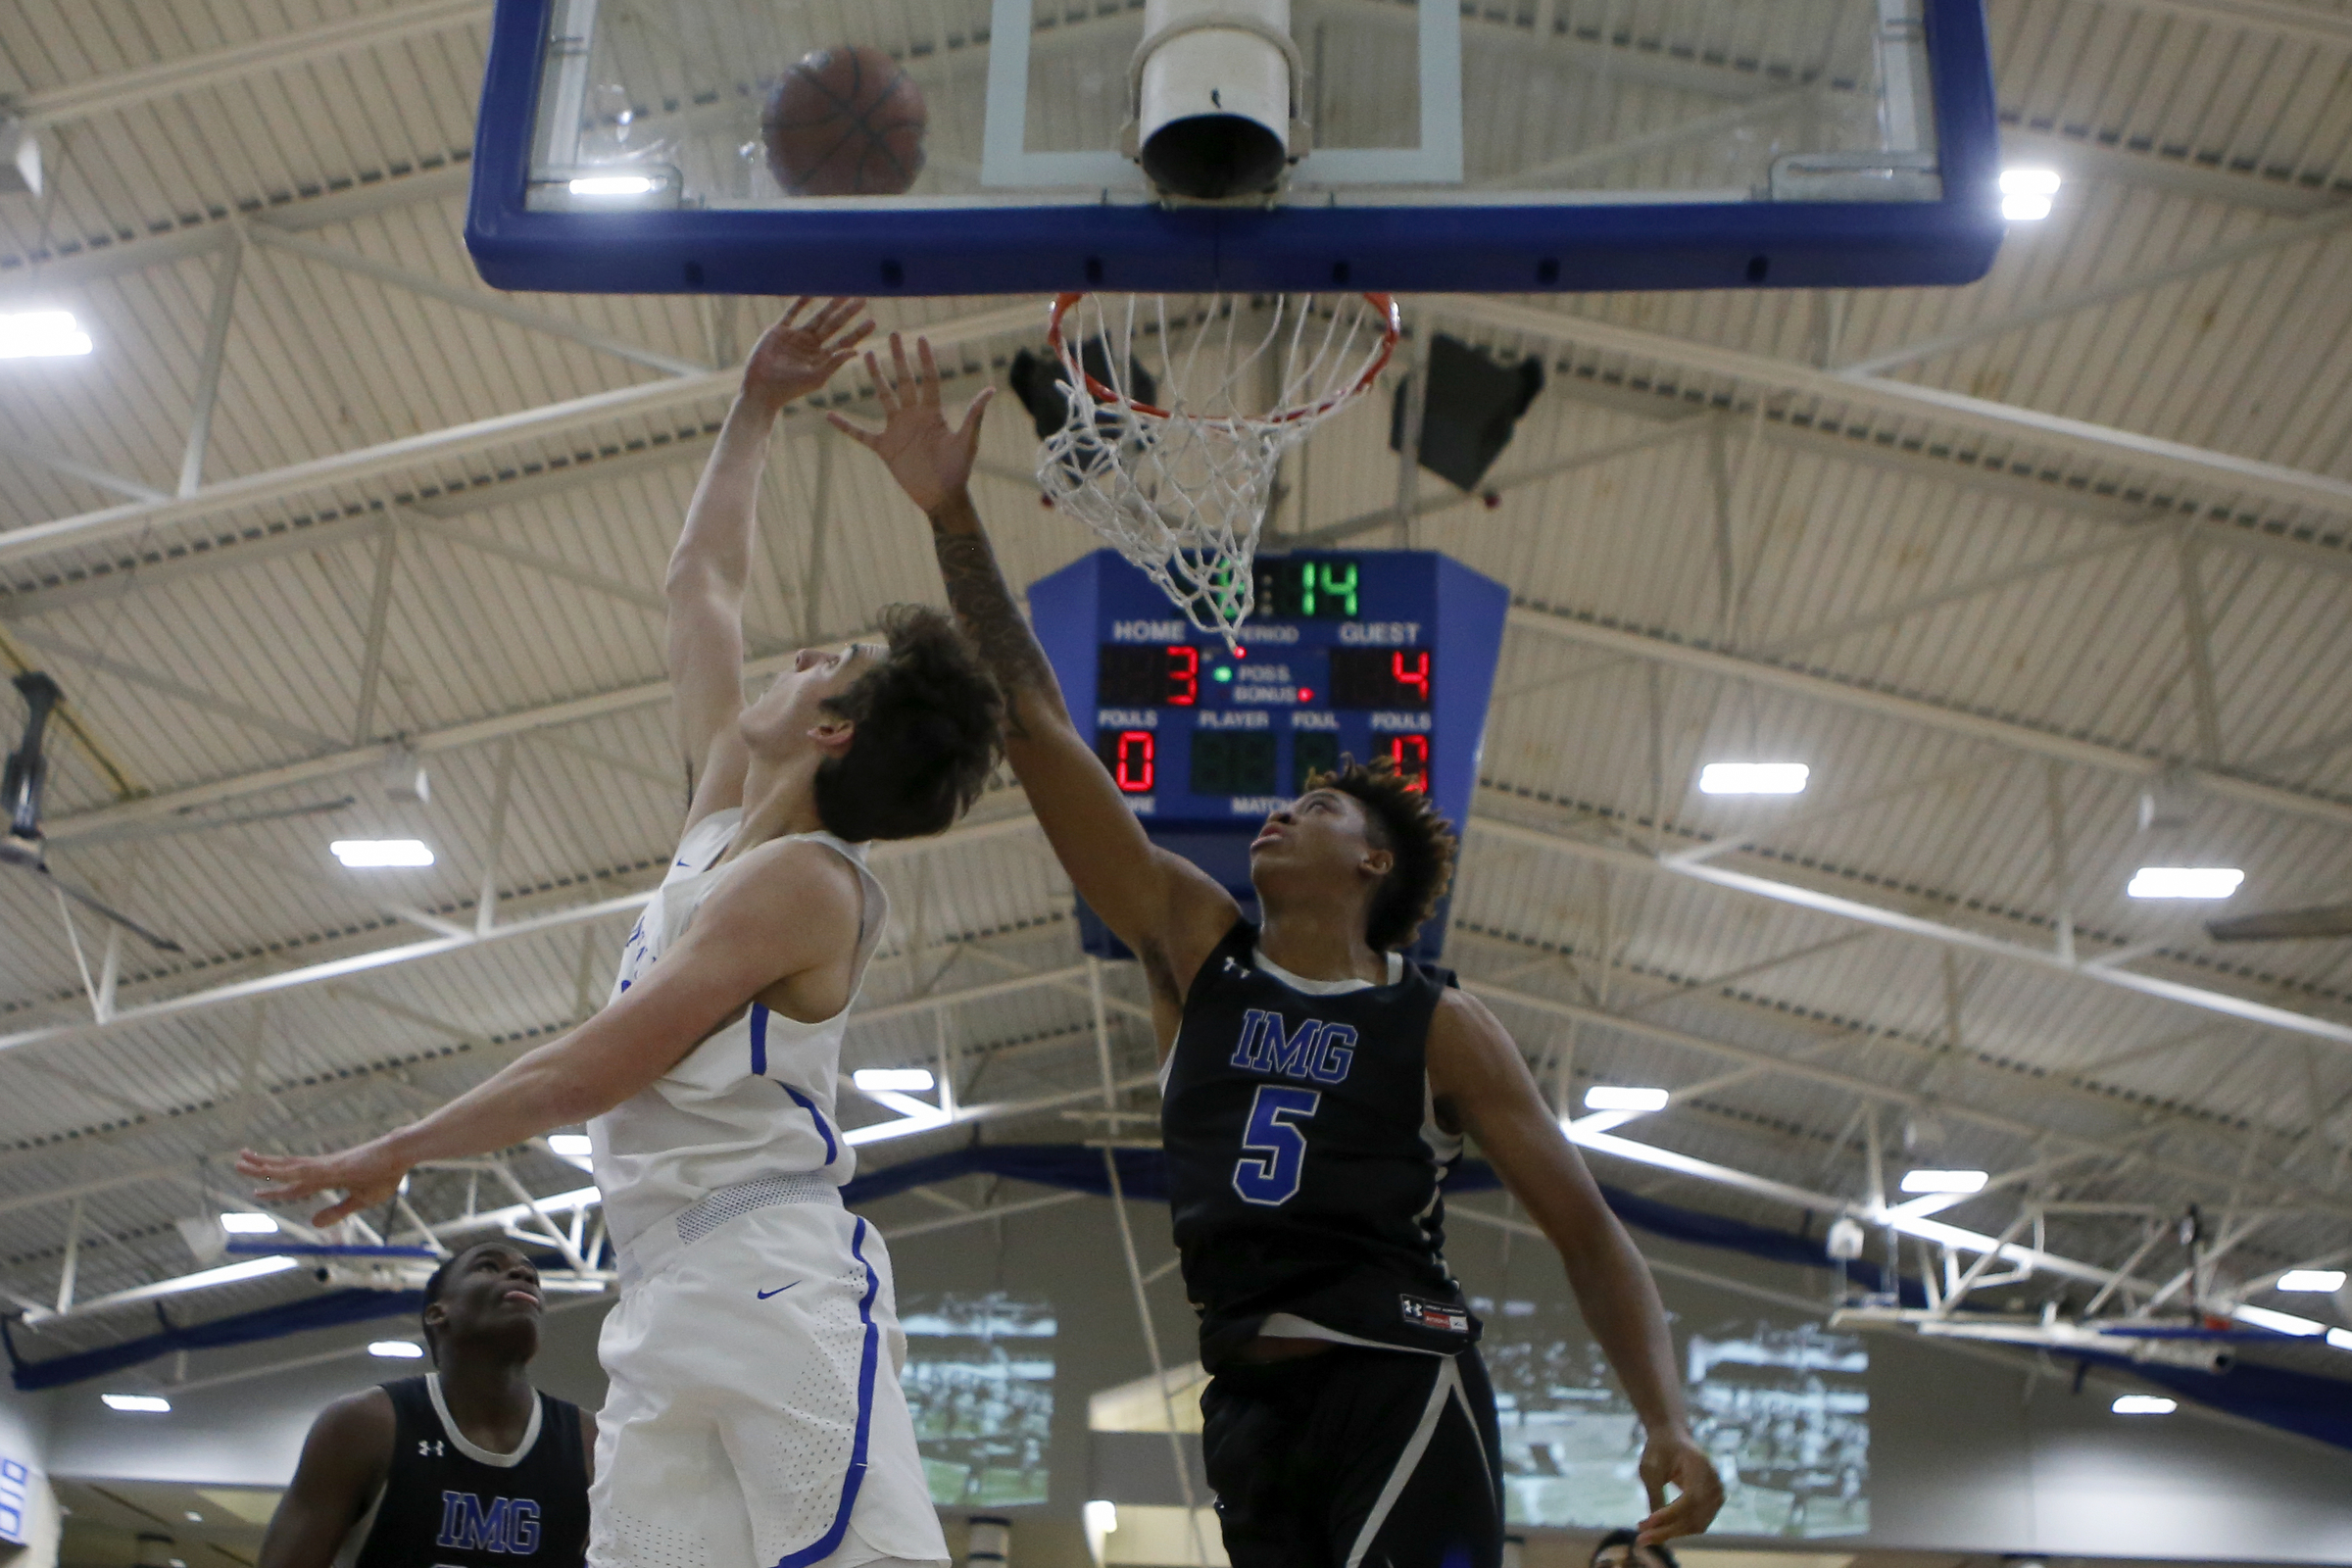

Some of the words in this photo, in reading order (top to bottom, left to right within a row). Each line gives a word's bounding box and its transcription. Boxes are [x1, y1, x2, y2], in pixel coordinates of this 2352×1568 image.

[1301, 561, 1357, 616] 14
[1112, 619, 1186, 643] HOME
[1339, 621, 1420, 646] GUEST
[1166, 646, 1199, 706] 3
[1234, 686, 1298, 703] BONUS
[1393, 651, 1429, 702] 4
[1098, 710, 1157, 727] FOULS
[1198, 710, 1270, 728] PLAYER
[1291, 710, 1339, 728] FOUL
[1371, 710, 1432, 730] FOULS
[1116, 730, 1154, 792] 0
[1230, 1007, 1359, 1085] IMG
[1232, 1084, 1322, 1206] 5
[436, 1490, 541, 1555] IMG
